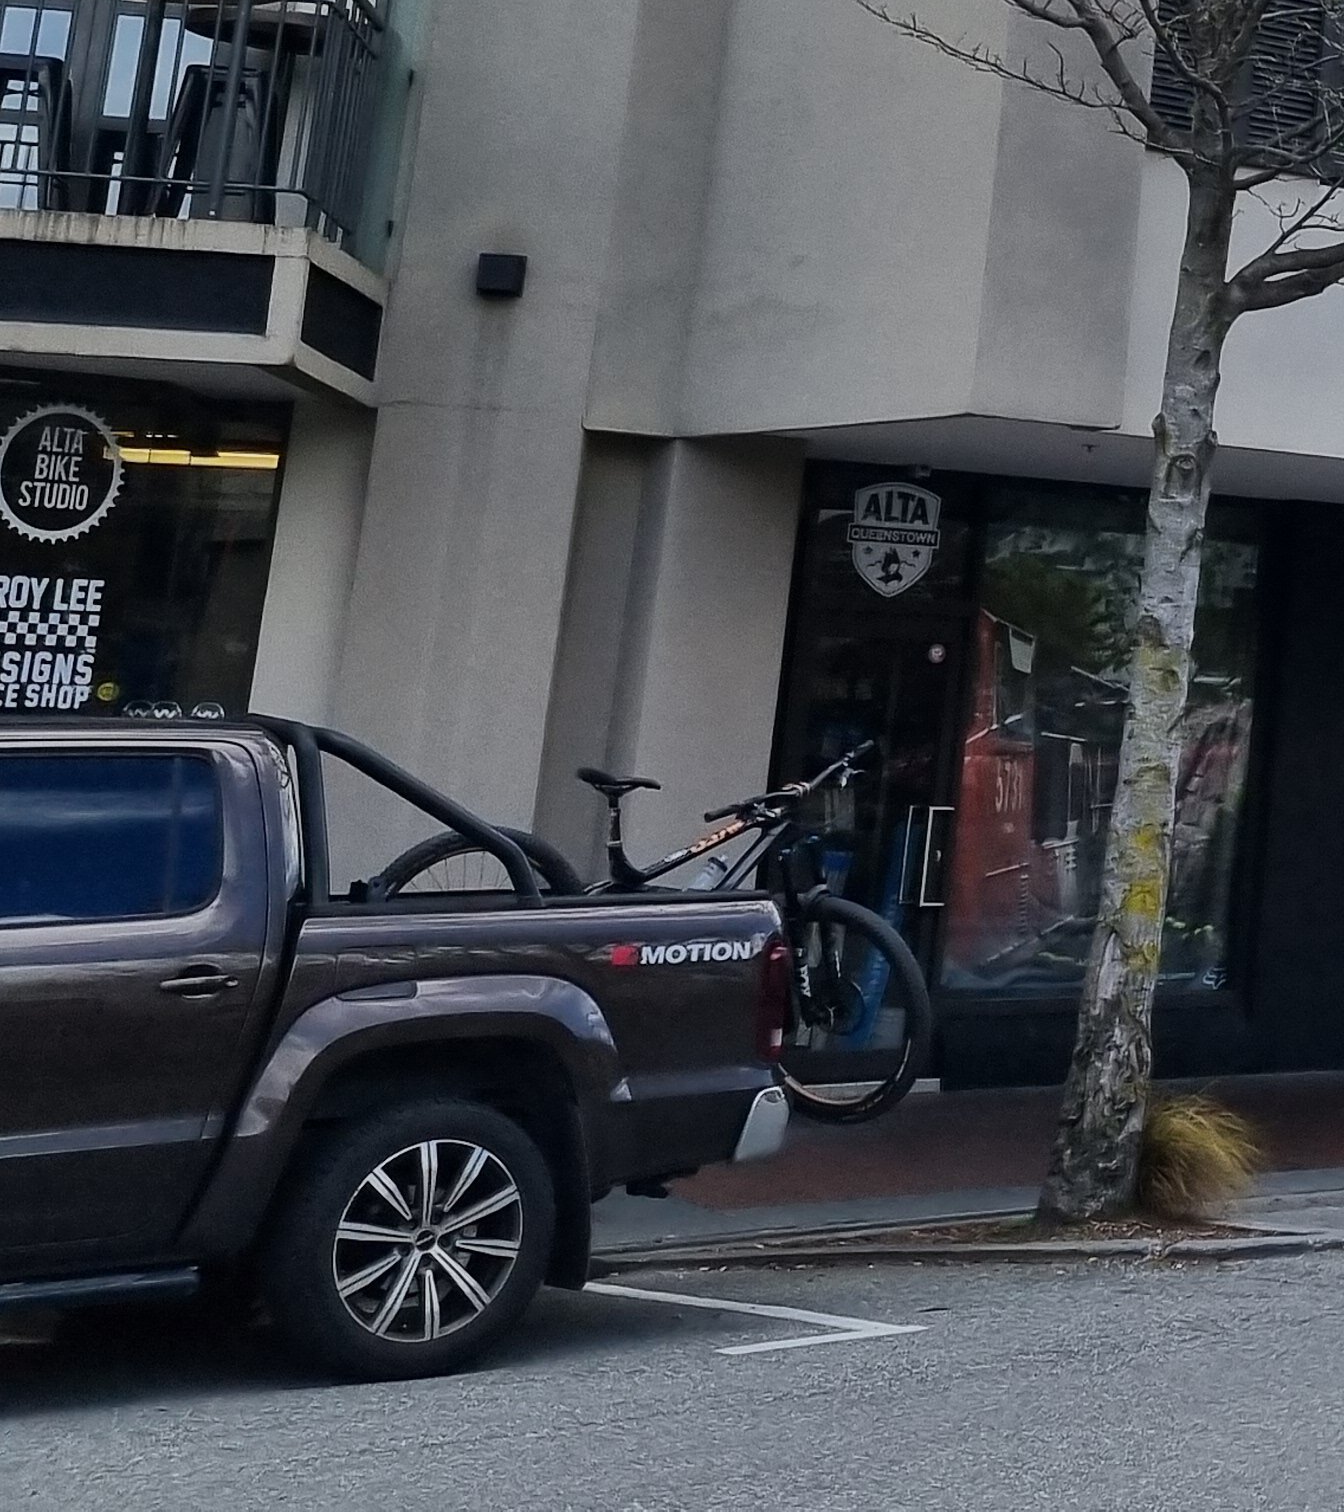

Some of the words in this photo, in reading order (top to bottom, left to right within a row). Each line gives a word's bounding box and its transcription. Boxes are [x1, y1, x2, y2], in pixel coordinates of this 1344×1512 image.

[38, 426, 85, 454] ALTA
[34, 454, 83, 482] BIKE
[18, 480, 89, 511] STUDIO
[861, 489, 930, 525] ALTA
[851, 527, 937, 544] QUEENSTOWN
[53, 578, 105, 611] LEE
[0, 650, 95, 685] SIGNS
[24, 683, 90, 709] SHOP
[640, 941, 750, 965] MOTION
